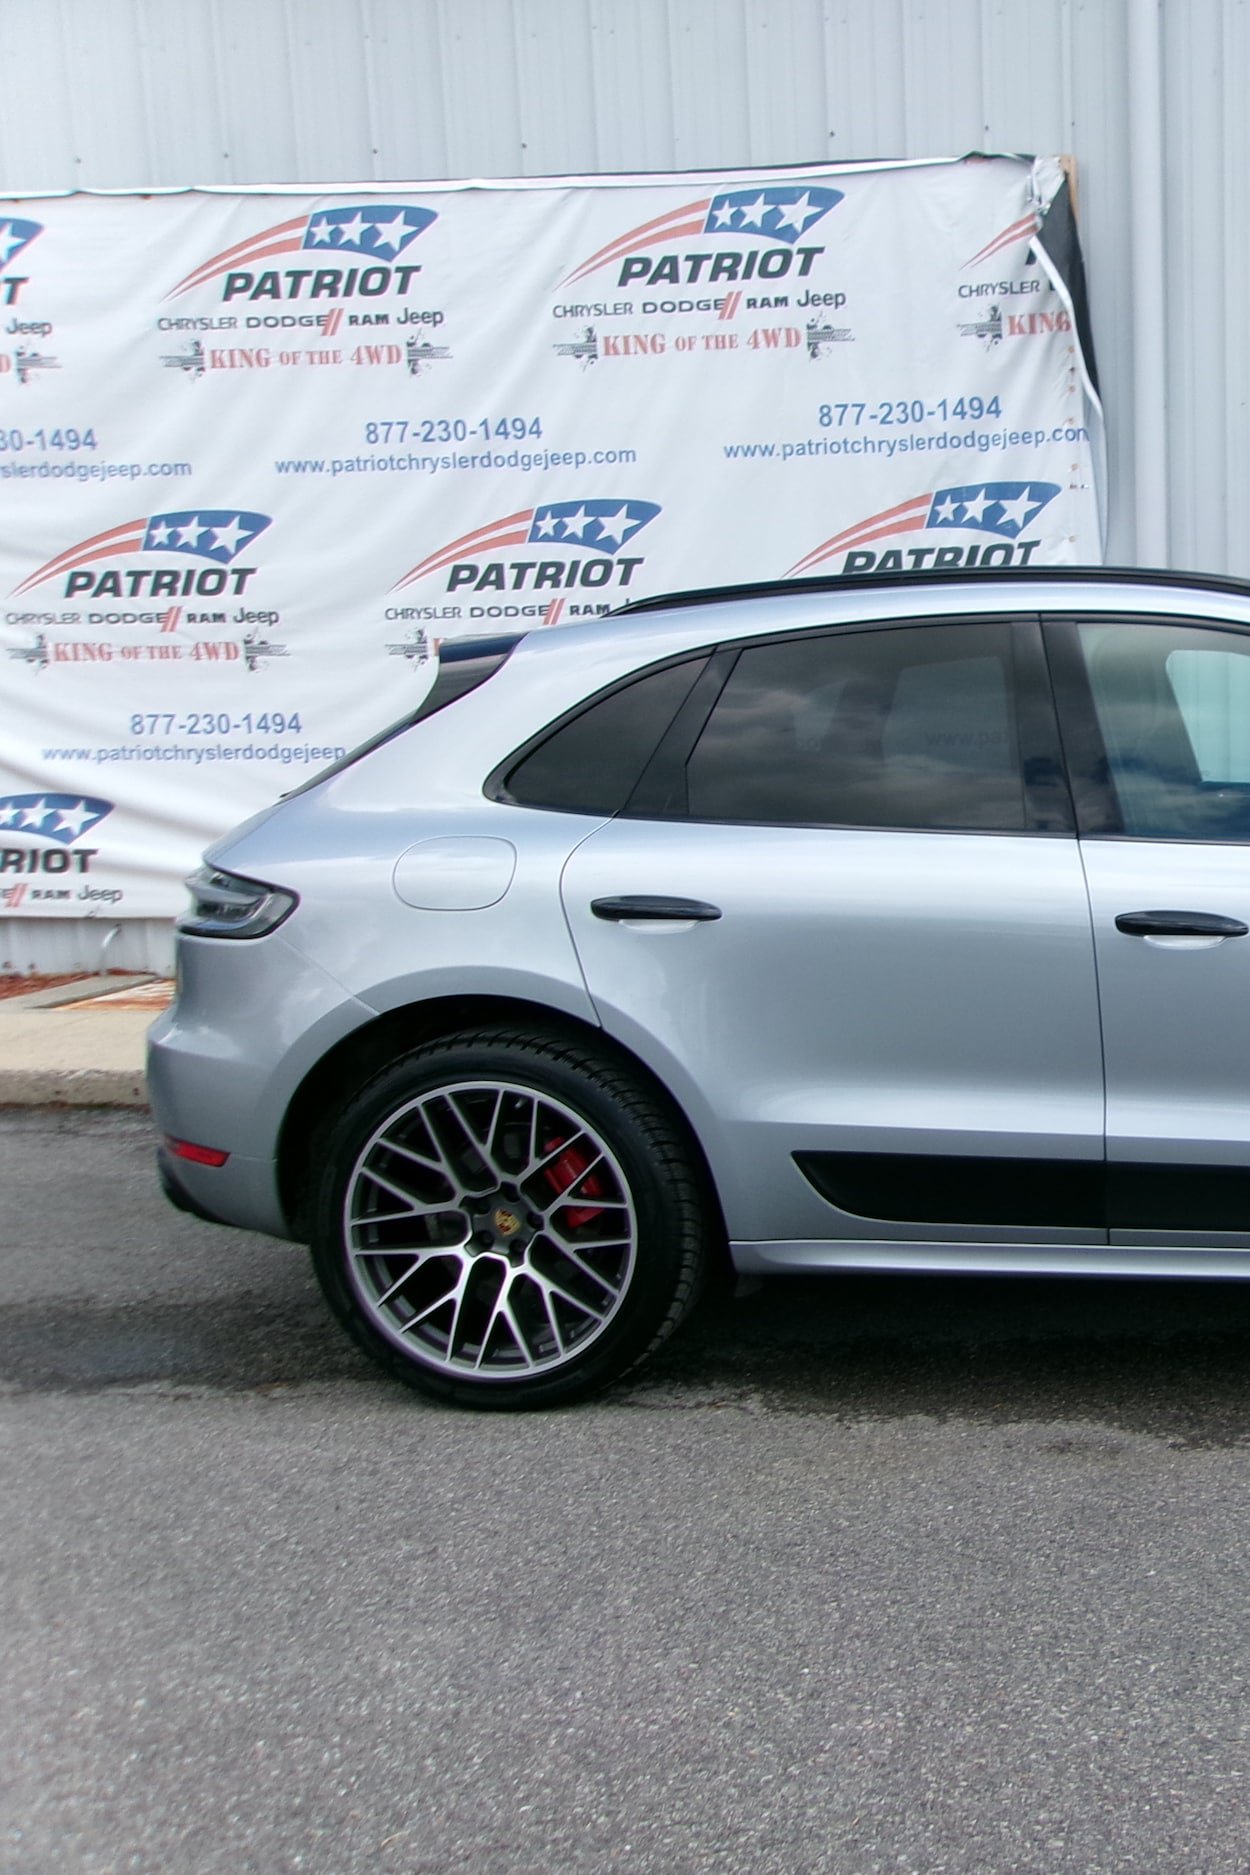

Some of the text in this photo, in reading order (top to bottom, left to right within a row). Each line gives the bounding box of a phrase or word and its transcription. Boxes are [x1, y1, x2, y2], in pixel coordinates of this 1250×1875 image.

[617, 247, 825, 287] PATRIOT
[222, 265, 422, 302] PATRIOT
[959, 280, 1040, 298] CHRYSLER
[552, 289, 847, 318] CHRYSLER DODGE RAM Jeep
[7, 318, 53, 338] Jeep
[157, 307, 445, 331] CHRYSLER DODGE RAM Jeep
[1007, 311, 1072, 337] KING
[603, 327, 803, 356] KING OF THE 4WD
[210, 344, 403, 370] KING OF THE 4WD
[818, 395, 1002, 427] 877-230-1494
[364, 416, 544, 445] 877-230-1494
[274, 448, 637, 477] www.patriotchryslerdodgejeep.com
[841, 539, 1042, 576] PATRIOT
[64, 567, 258, 598] PATRIOT
[446, 556, 645, 593] PATRIOT
[6, 607, 280, 627] CHRYSLER DODGE RAM Jeep
[385, 606, 462, 621] CHRYSLER
[470, 604, 548, 619] DODGE
[569, 602, 611, 616] RAM
[53, 641, 241, 662] KING OF THE 4WD
[130, 711, 303, 736] 877-230-1494
[31, 888, 71, 900] RAM
[78, 885, 124, 904] Jeep
